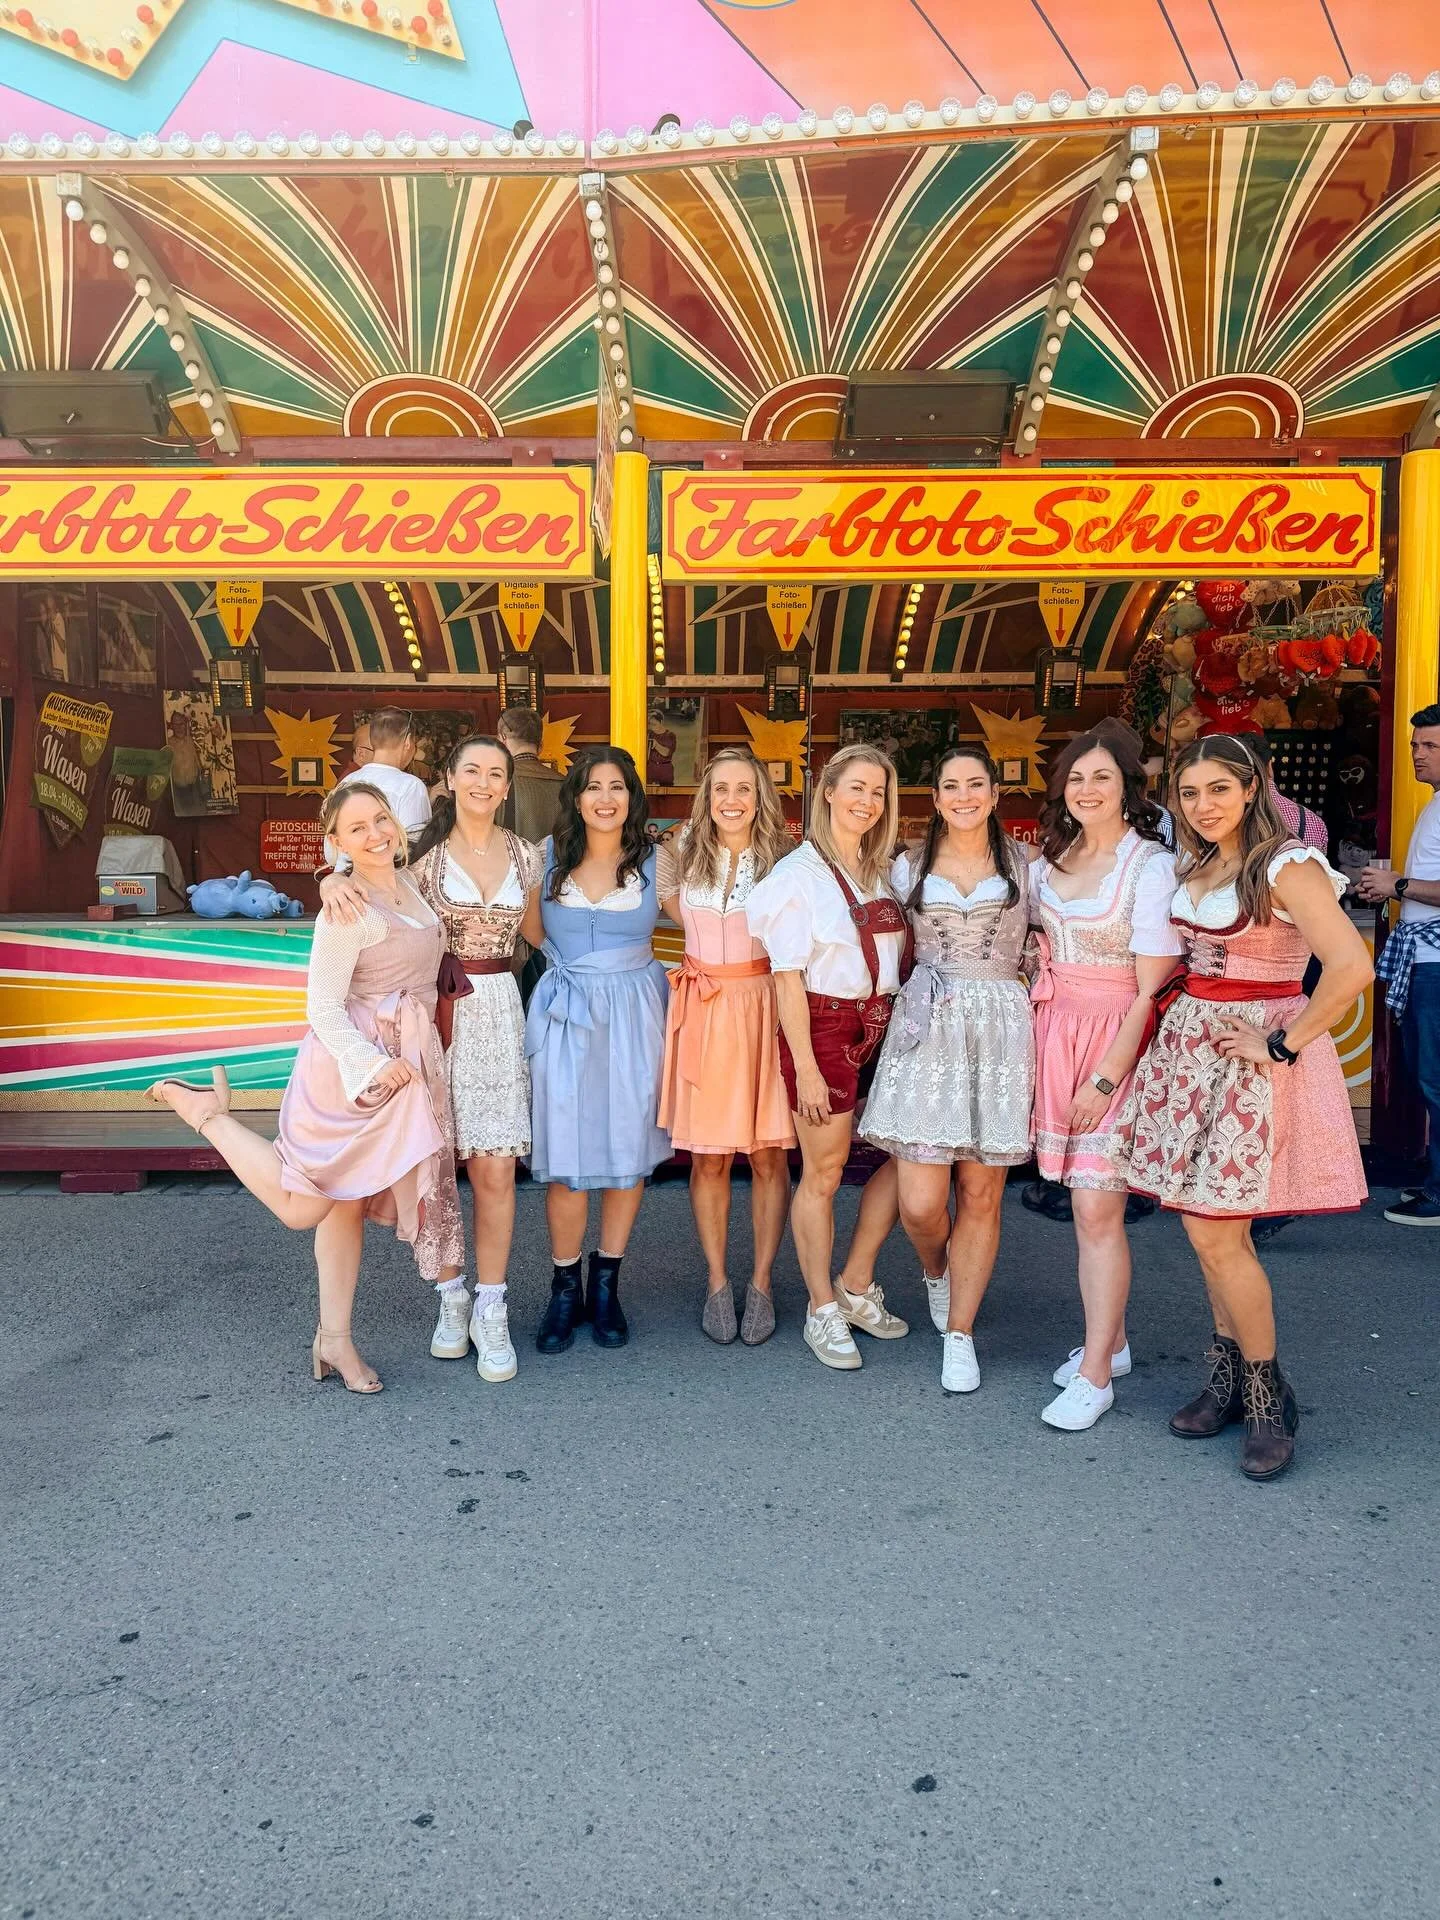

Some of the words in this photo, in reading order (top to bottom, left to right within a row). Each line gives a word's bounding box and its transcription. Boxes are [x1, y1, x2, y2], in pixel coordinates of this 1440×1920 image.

[0, 483, 574, 555] rbfoto-Schießen
[688, 484, 1361, 557] Farbfoto-Schießen
[229, 586, 251, 594] Foto-
[1051, 586, 1073, 594] Foto-
[1216, 583, 1236, 593] hab
[511, 591, 533, 599] Foto-
[1211, 593, 1235, 603] dich
[503, 601, 540, 609] schießen
[771, 601, 807, 609] schießen
[1043, 597, 1080, 605] schießen
[1215, 602, 1233, 612] lieb
[46, 695, 111, 726] MUSIKFEUERWERK
[1221, 703, 1242, 715] lieb
[42, 734, 88, 795] Wasen
[111, 787, 151, 828] Wasen
[264, 835, 285, 843] Jeder
[286, 835, 301, 843] 12er
[1013, 826, 1038, 843] Fot
[278, 844, 299, 852] Jeder
[301, 844, 316, 852] 10er
[264, 852, 297, 860] TREFFER
[299, 852, 318, 860] zählt
[275, 861, 288, 870] 100
[290, 861, 316, 870] Punkte
[121, 887, 146, 895] WILD!
